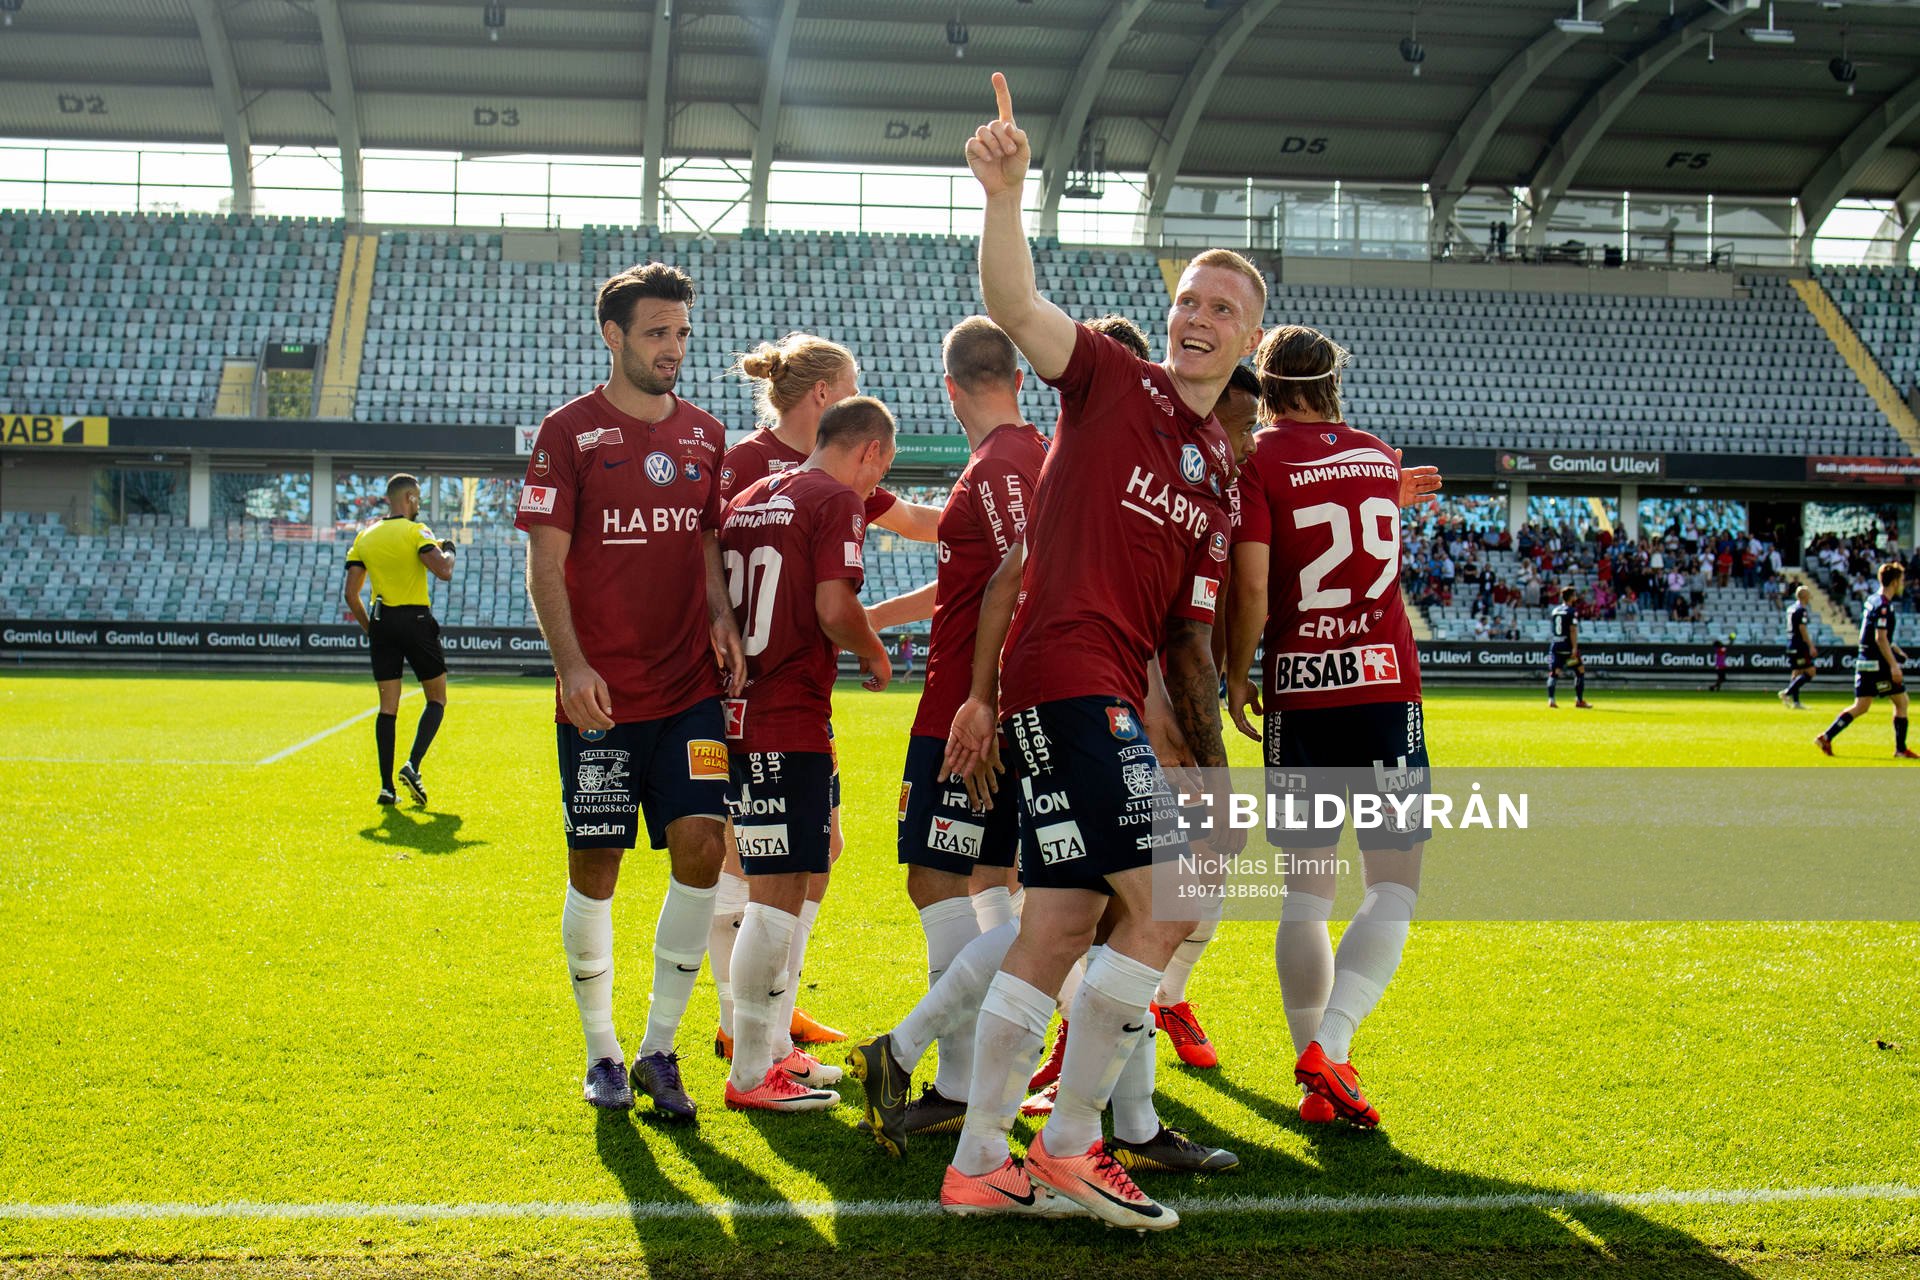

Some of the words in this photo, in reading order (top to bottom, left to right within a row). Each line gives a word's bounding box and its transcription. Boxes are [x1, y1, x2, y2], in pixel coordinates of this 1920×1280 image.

[59, 94, 108, 114] D2
[474, 107, 520, 127] D3
[885, 121, 932, 140] D4
[1280, 137, 1329, 154] D5
[1666, 152, 1711, 169] F5
[0, 416, 54, 442] AB
[1549, 455, 1607, 472] Gamla
[1611, 456, 1660, 473] Ullevi
[1290, 463, 1399, 488] HAMMARVIKEN
[1002, 474, 1028, 534] adium
[1126, 465, 1170, 514] H.A
[1169, 493, 1209, 539] BYG
[603, 508, 648, 533] H.A
[652, 507, 703, 532] BYG
[1293, 496, 1401, 612] 29
[3, 629, 52, 644] Gamla
[55, 630, 97, 645] Ullevi
[105, 631, 154, 645] Gamla
[157, 632, 200, 646] Ullevi
[207, 632, 256, 647] Gamla
[258, 633, 300, 648] Ullevi
[308, 633, 356, 648] Gamla
[460, 636, 502, 650] Ullevi
[509, 637, 551, 651] Gaml
[1432, 651, 1472, 664] Ullevi
[1478, 652, 1523, 665] Gamla
[1525, 652, 1554, 665] Ulle
[1583, 654, 1614, 665] amla
[1616, 652, 1655, 666] Ullevi
[1661, 653, 1705, 666] Gamla
[1706, 653, 1744, 667] Uevi
[1276, 652, 1360, 691] BESAB
[1407, 702, 1415, 755] nsson
[1012, 713, 1040, 777] nsson
[573, 793, 631, 804] STIFTELSEN
[573, 804, 637, 814] UNROSS&CO
[576, 822, 626, 836] stadium
